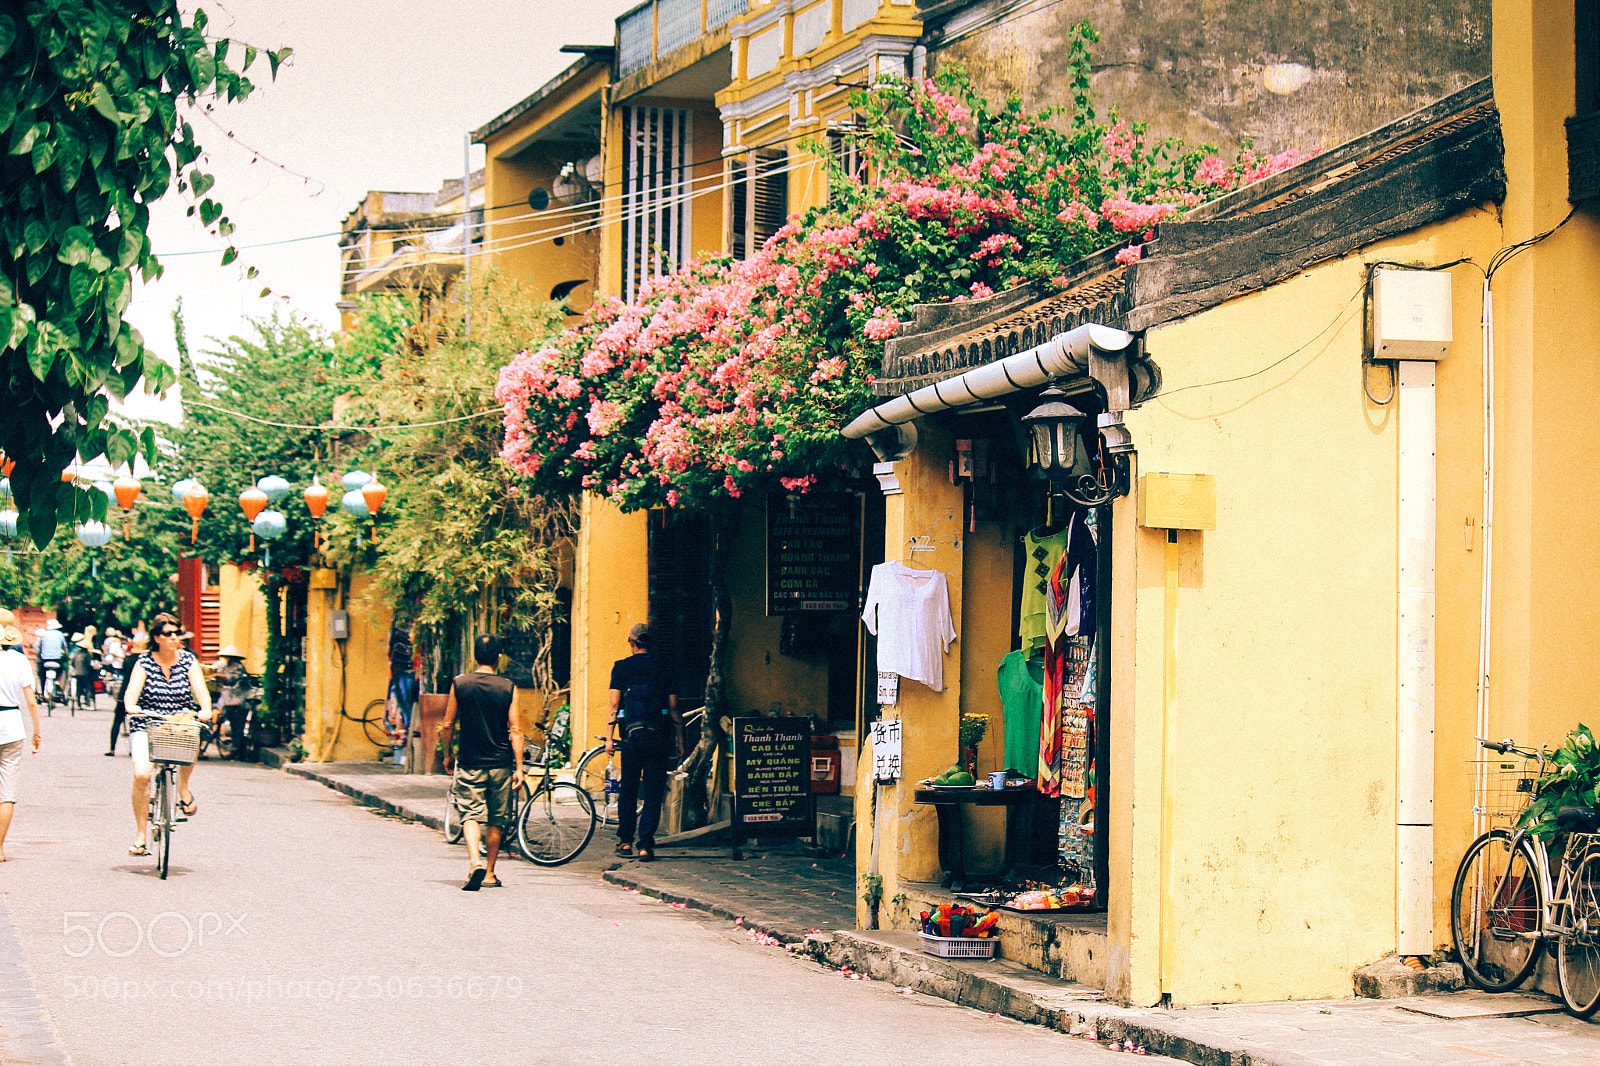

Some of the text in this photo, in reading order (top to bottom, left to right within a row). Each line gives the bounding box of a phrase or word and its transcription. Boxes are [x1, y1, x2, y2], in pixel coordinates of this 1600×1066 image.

[742, 733, 803, 743] Thanh Thanh
[873, 721, 900, 745] 货币
[876, 754, 900, 776] 兑换
